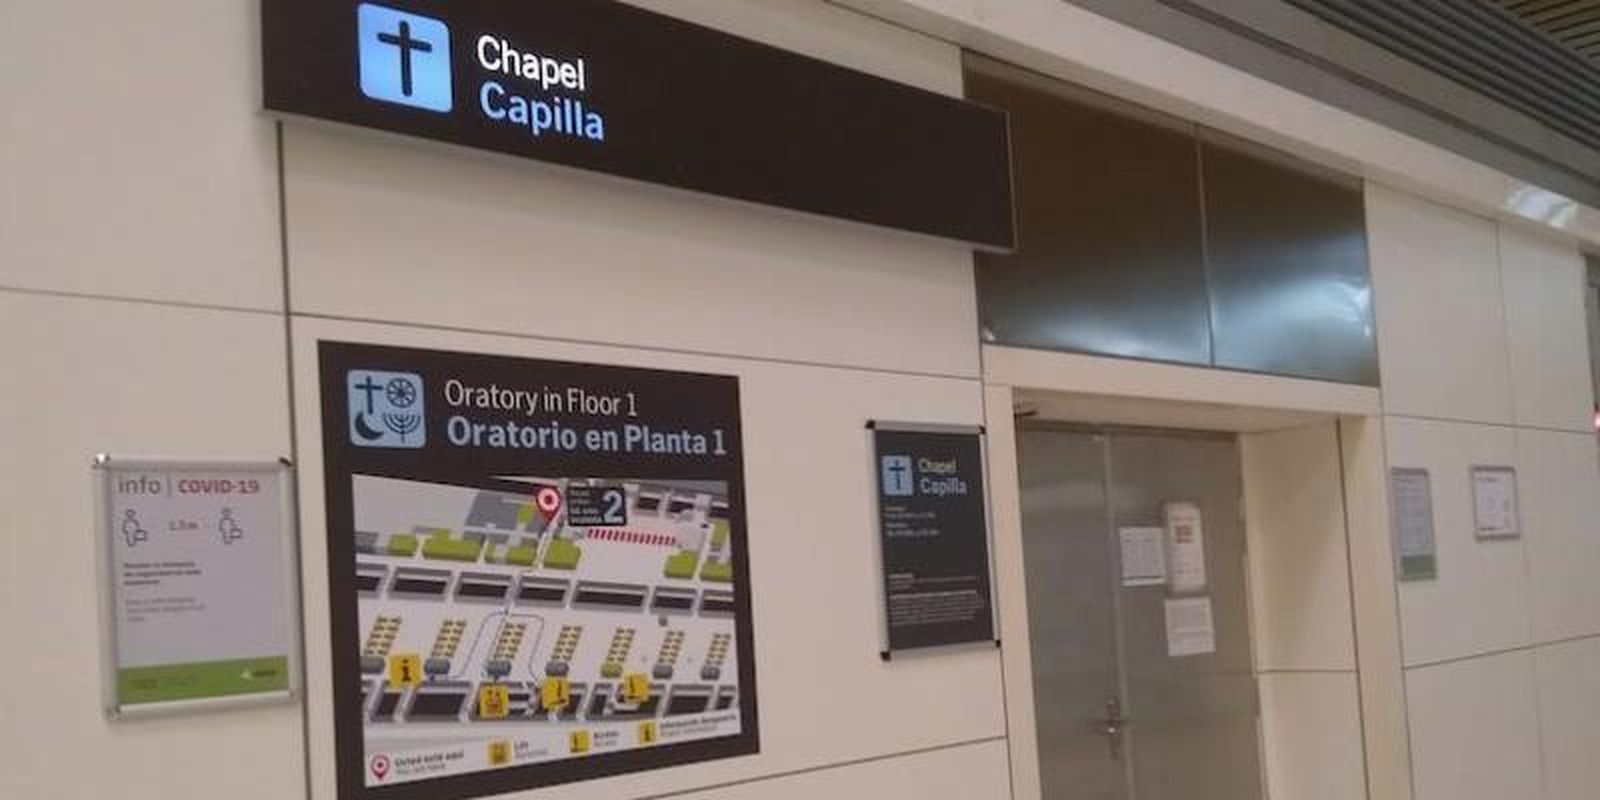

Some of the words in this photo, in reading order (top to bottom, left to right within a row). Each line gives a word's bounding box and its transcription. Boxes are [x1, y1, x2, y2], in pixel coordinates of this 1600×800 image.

[477, 35, 586, 91] Chapel
[479, 81, 605, 141] Capilla
[444, 379, 539, 417] Oratory
[544, 385, 563, 412] in
[567, 387, 621, 415] Floor
[626, 393, 638, 417] 1
[447, 414, 578, 451] Oratorio
[585, 428, 619, 452] en
[625, 426, 707, 456] Planta
[713, 429, 728, 456] 1
[918, 458, 957, 475] Chapel
[118, 476, 161, 495] info
[177, 478, 261, 496] COVID-19
[920, 477, 968, 498] Capilla
[602, 490, 625, 523] 2
